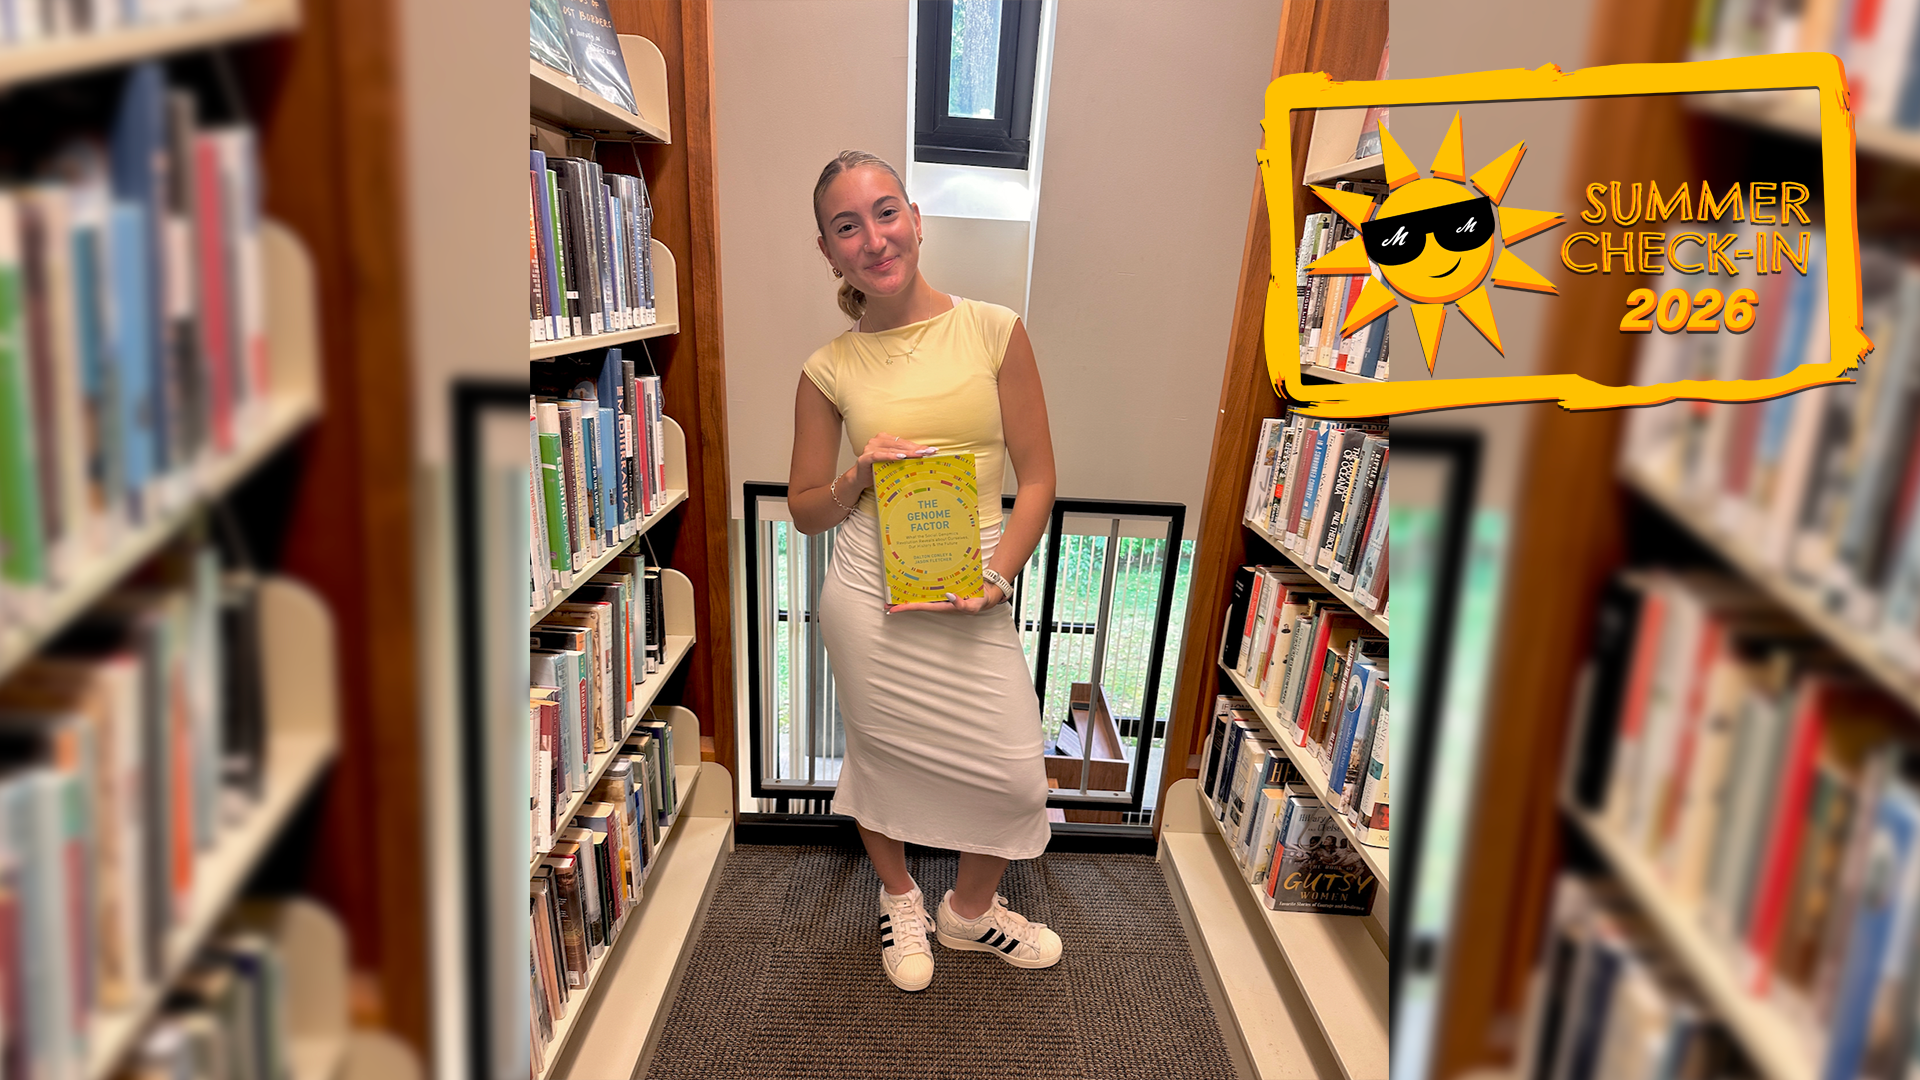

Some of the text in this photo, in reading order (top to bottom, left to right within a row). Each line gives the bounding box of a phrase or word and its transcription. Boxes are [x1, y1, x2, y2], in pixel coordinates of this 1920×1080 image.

[563, 6, 575, 19] OST
[558, 249, 564, 262] WE
[560, 265, 565, 278] GO
[615, 398, 631, 520] MEDITERRANEAN
[1333, 459, 1350, 496] OCEANIA
[556, 455, 567, 520] ESSENTIAL
[1305, 478, 1315, 499] COUNTRY
[918, 499, 938, 509] THE
[594, 507, 599, 516] OF
[907, 510, 951, 521] GENOME
[911, 521, 949, 532] FACTOR
[1324, 525, 1337, 550] THEROU
[1377, 713, 1390, 750] GENIUS
[1284, 872, 1375, 894] GUTSY
[1300, 892, 1348, 901] WOMEN
